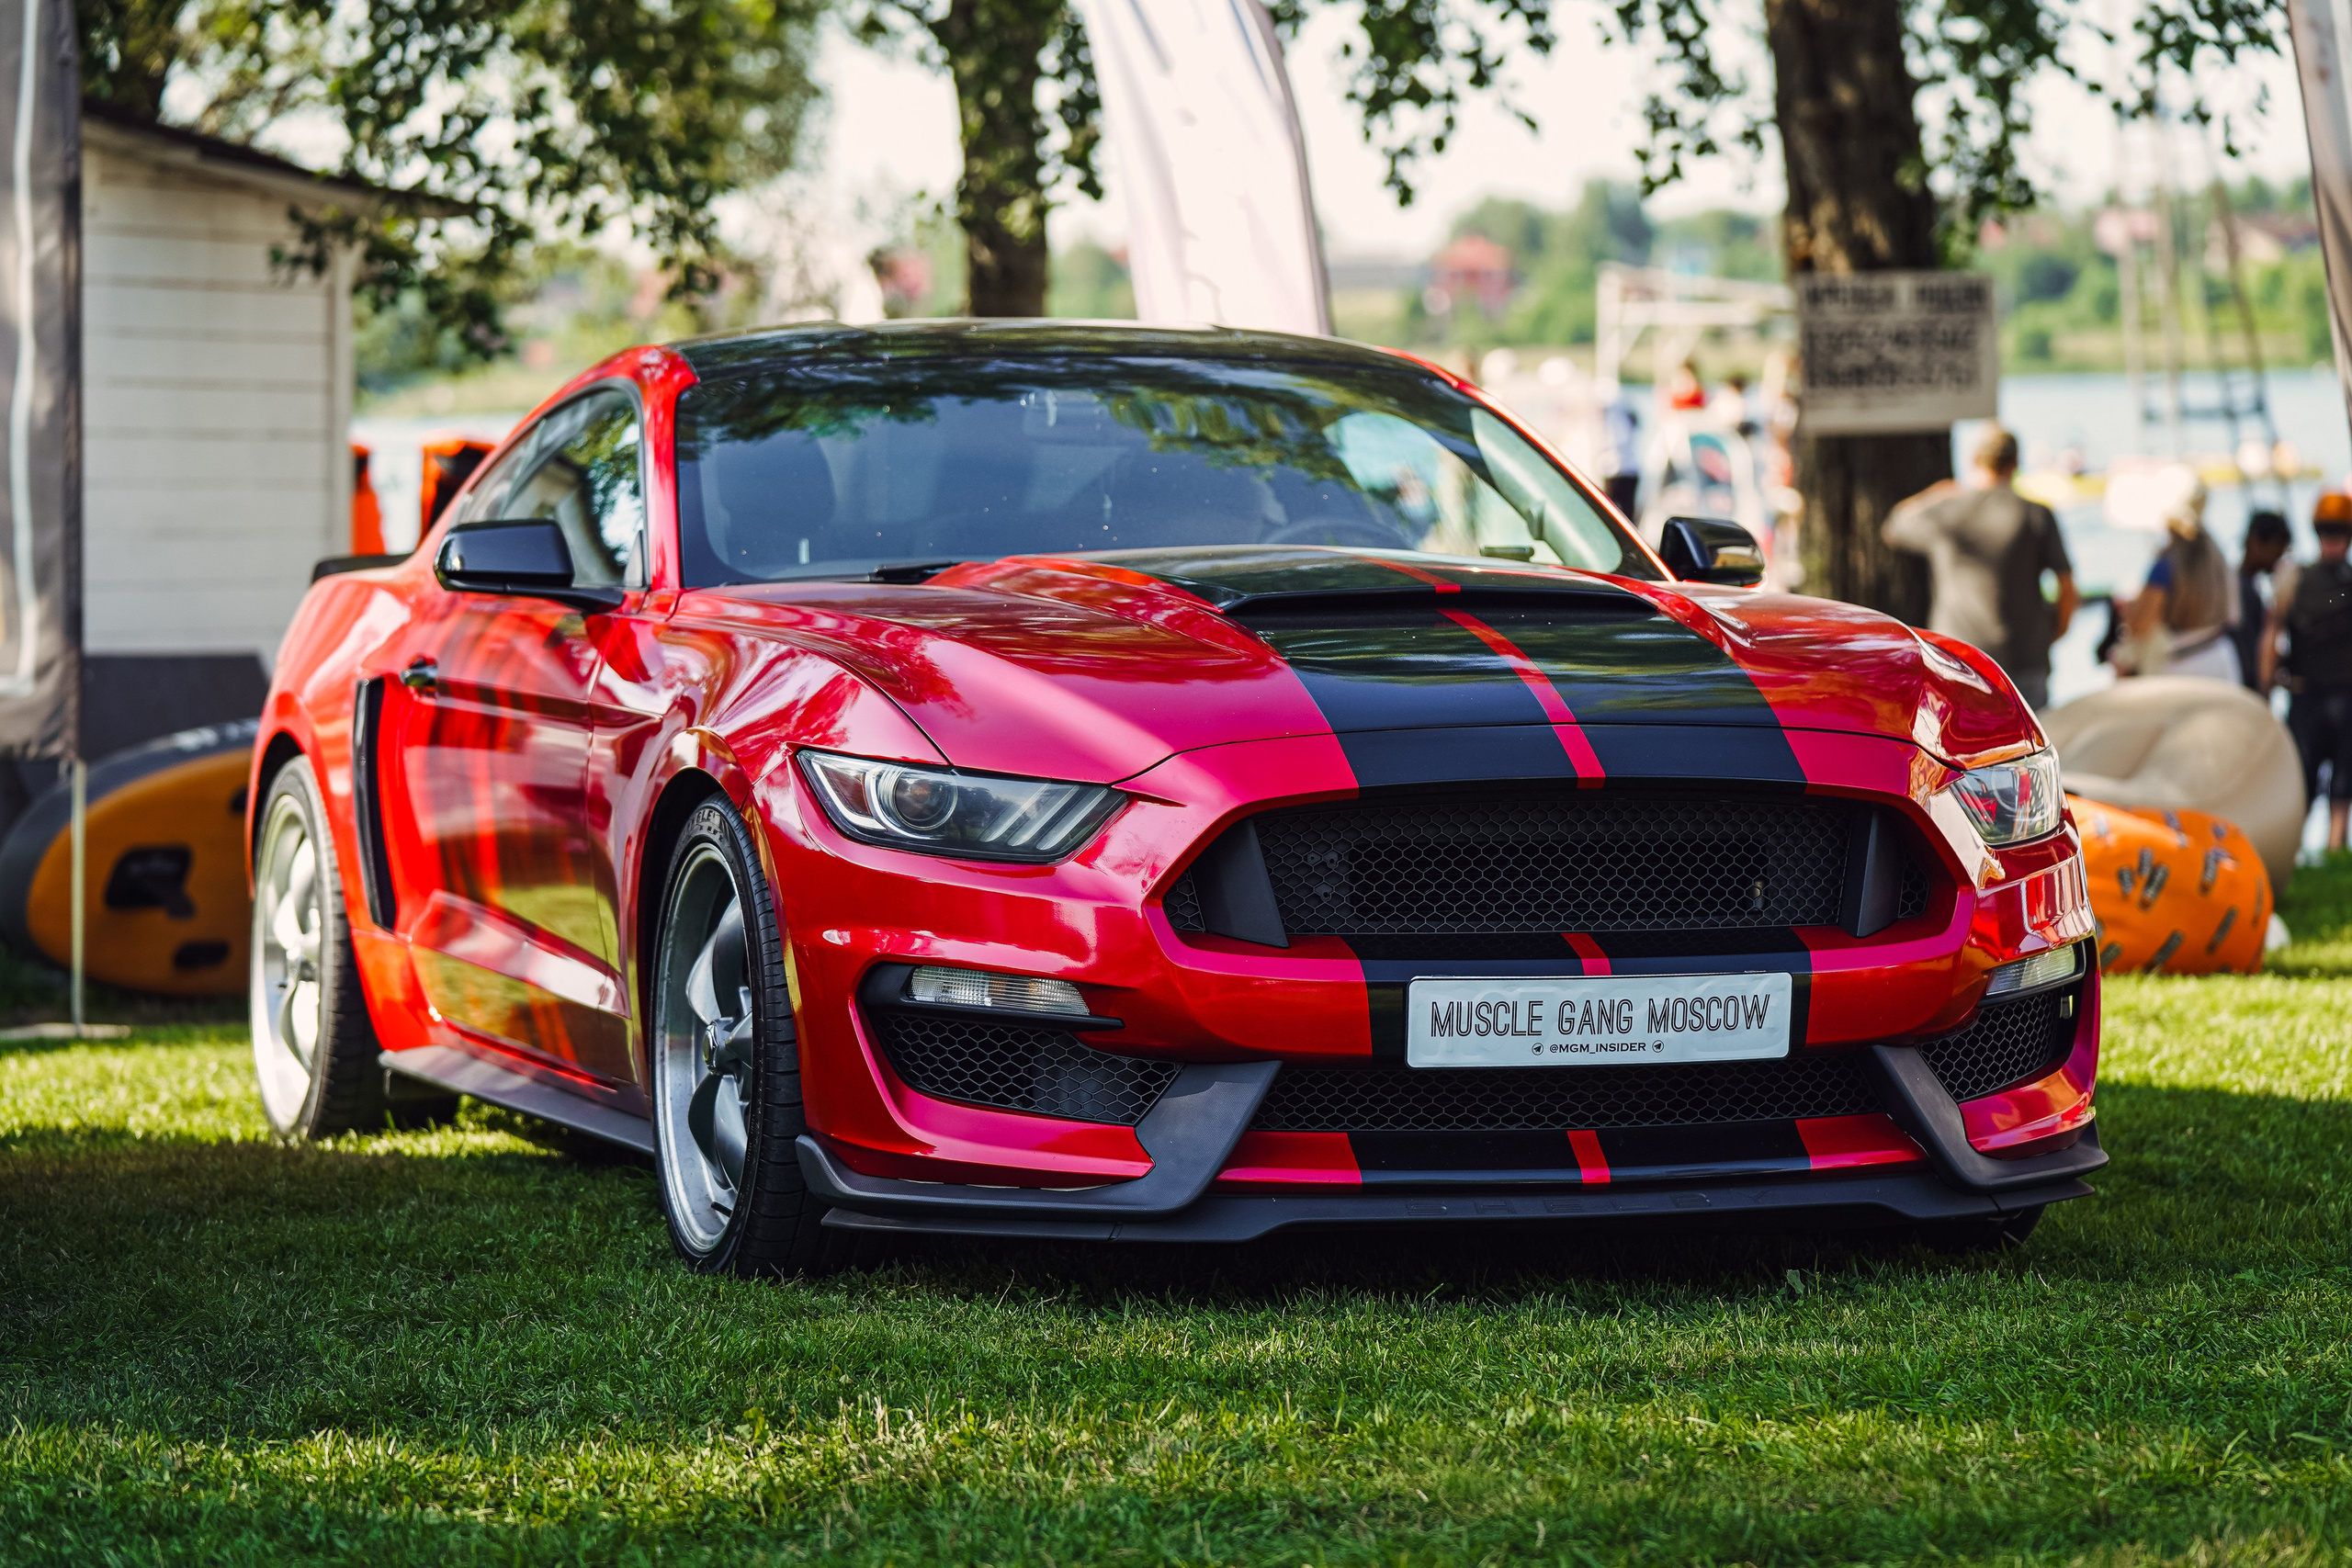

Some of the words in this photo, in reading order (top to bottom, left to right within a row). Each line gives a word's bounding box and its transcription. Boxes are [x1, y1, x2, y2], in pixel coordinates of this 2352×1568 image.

[1430, 1000, 1544, 1038] MUSCLE
[1557, 998, 1634, 1035] GANG
[1647, 993, 1770, 1034] MOSCOW
[1549, 1042, 1646, 1055] @MGM_INSIDER
